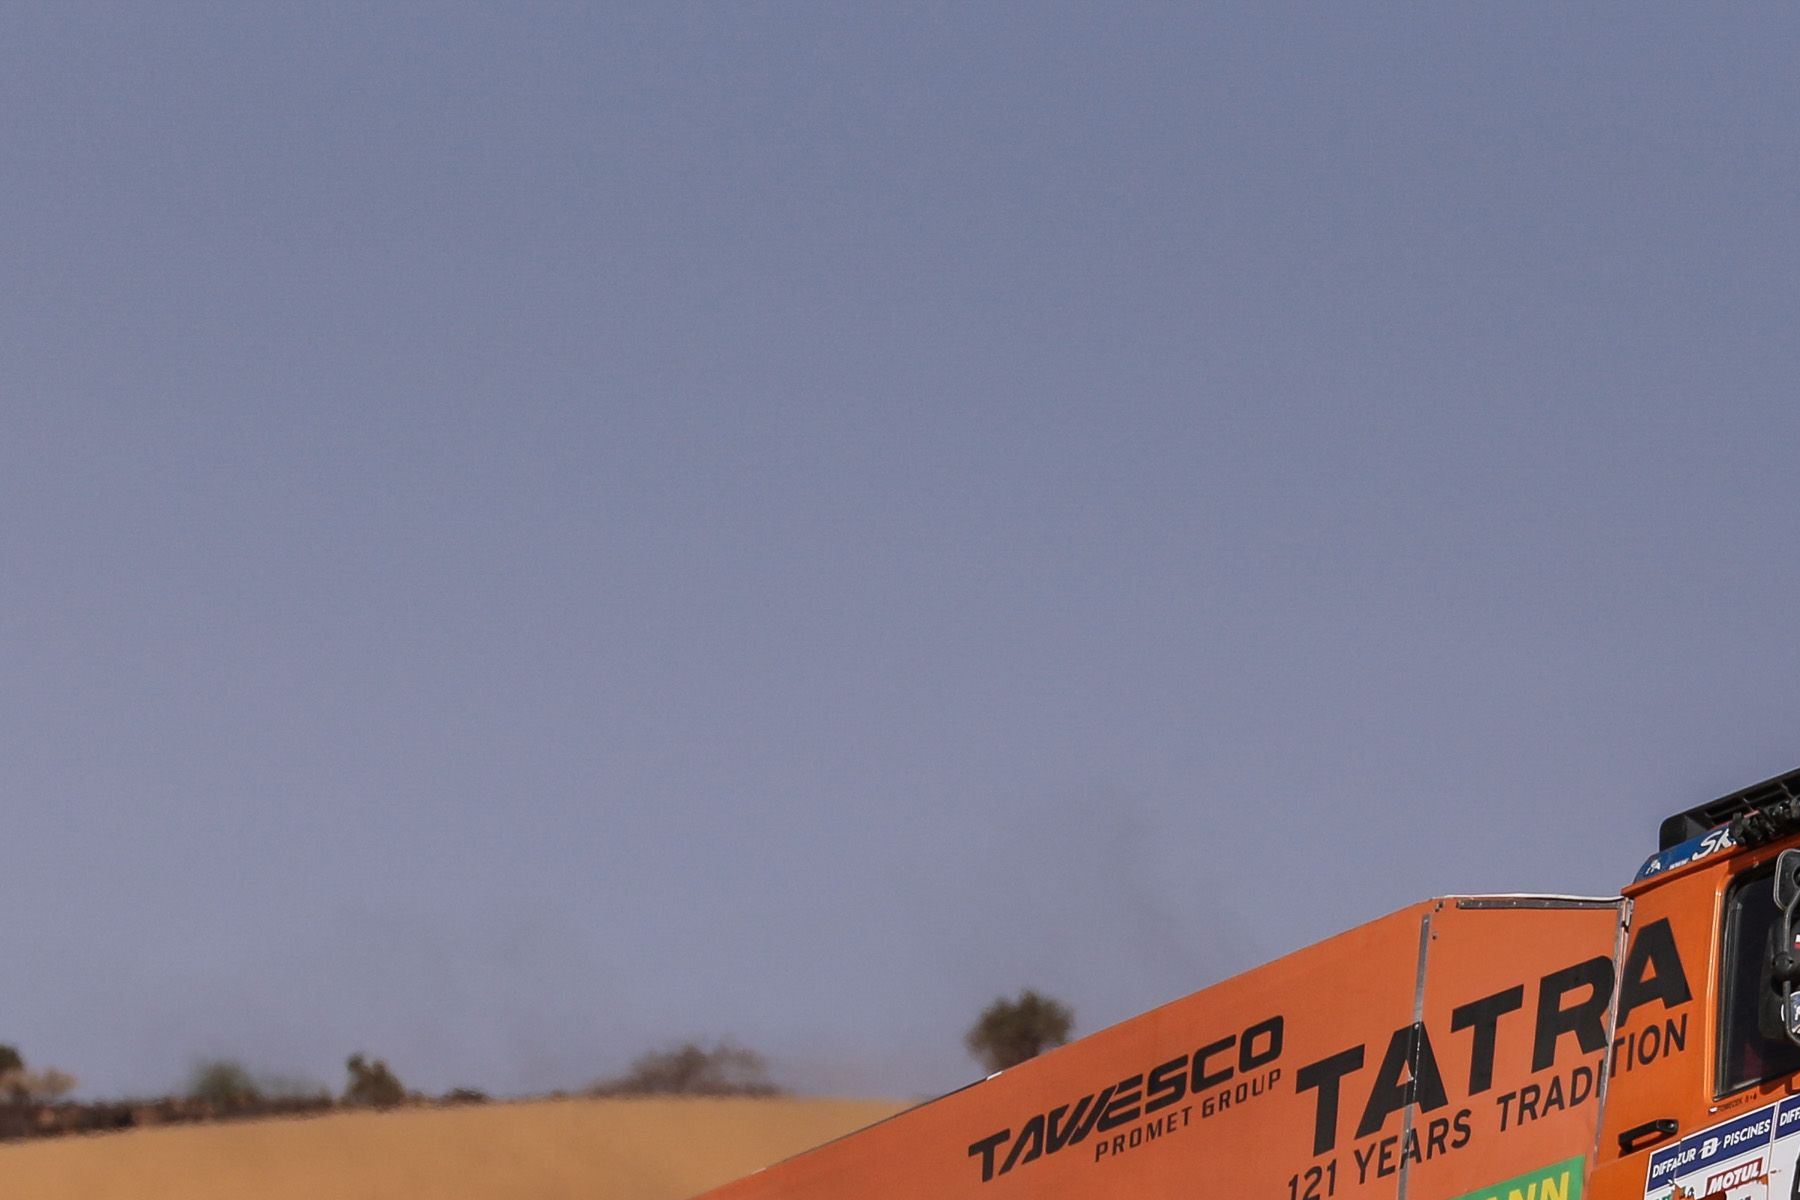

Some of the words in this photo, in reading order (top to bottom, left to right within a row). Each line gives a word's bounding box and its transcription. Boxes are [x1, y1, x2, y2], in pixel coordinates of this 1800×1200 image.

[968, 1015, 1284, 1182] TAWESCO
[1295, 917, 1694, 1155] TATRA
[1353, 1109, 1471, 1186] YEARS
[1497, 1013, 1688, 1134] TRADITION
[1094, 1108, 1193, 1163] PROMET
[1201, 1069, 1283, 1120] GROUP
[1651, 1148, 1696, 1179] DIFFAZUR
[1723, 1119, 1771, 1149] PISCINES
[1707, 1161, 1760, 1196] MOTUL
